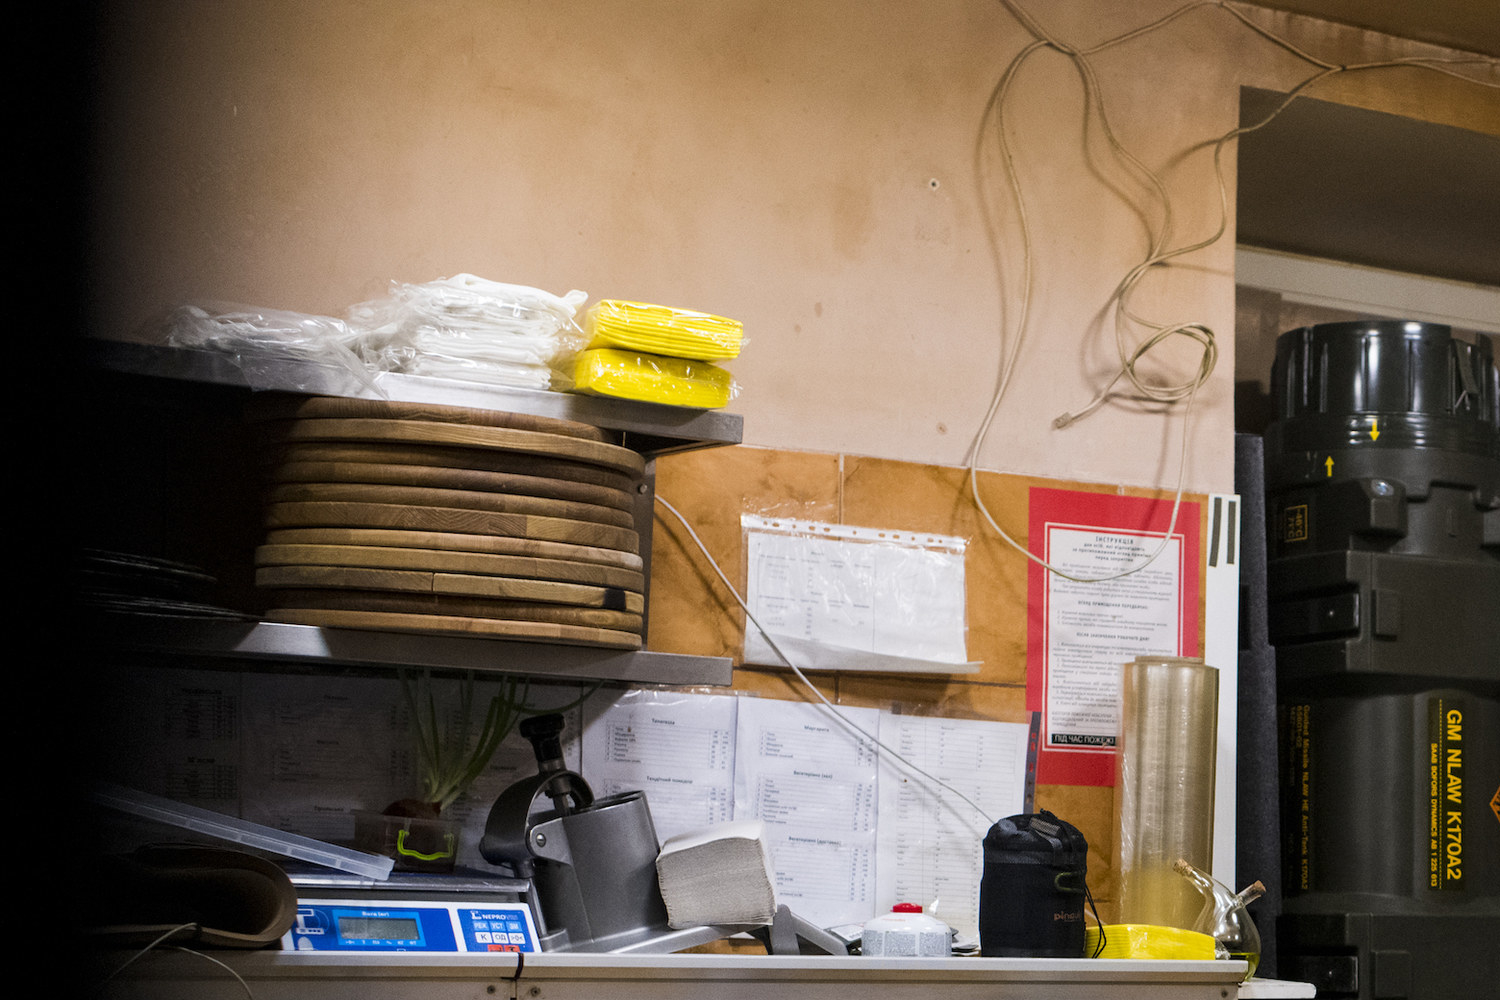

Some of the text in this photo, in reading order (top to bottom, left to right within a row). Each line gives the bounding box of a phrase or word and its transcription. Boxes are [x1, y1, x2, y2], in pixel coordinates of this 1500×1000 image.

[1054, 735, 1068, 743] ПІД
[1068, 735, 1083, 743] ЧАС
[1446, 709, 1463, 880] GM NLAW K170A2
